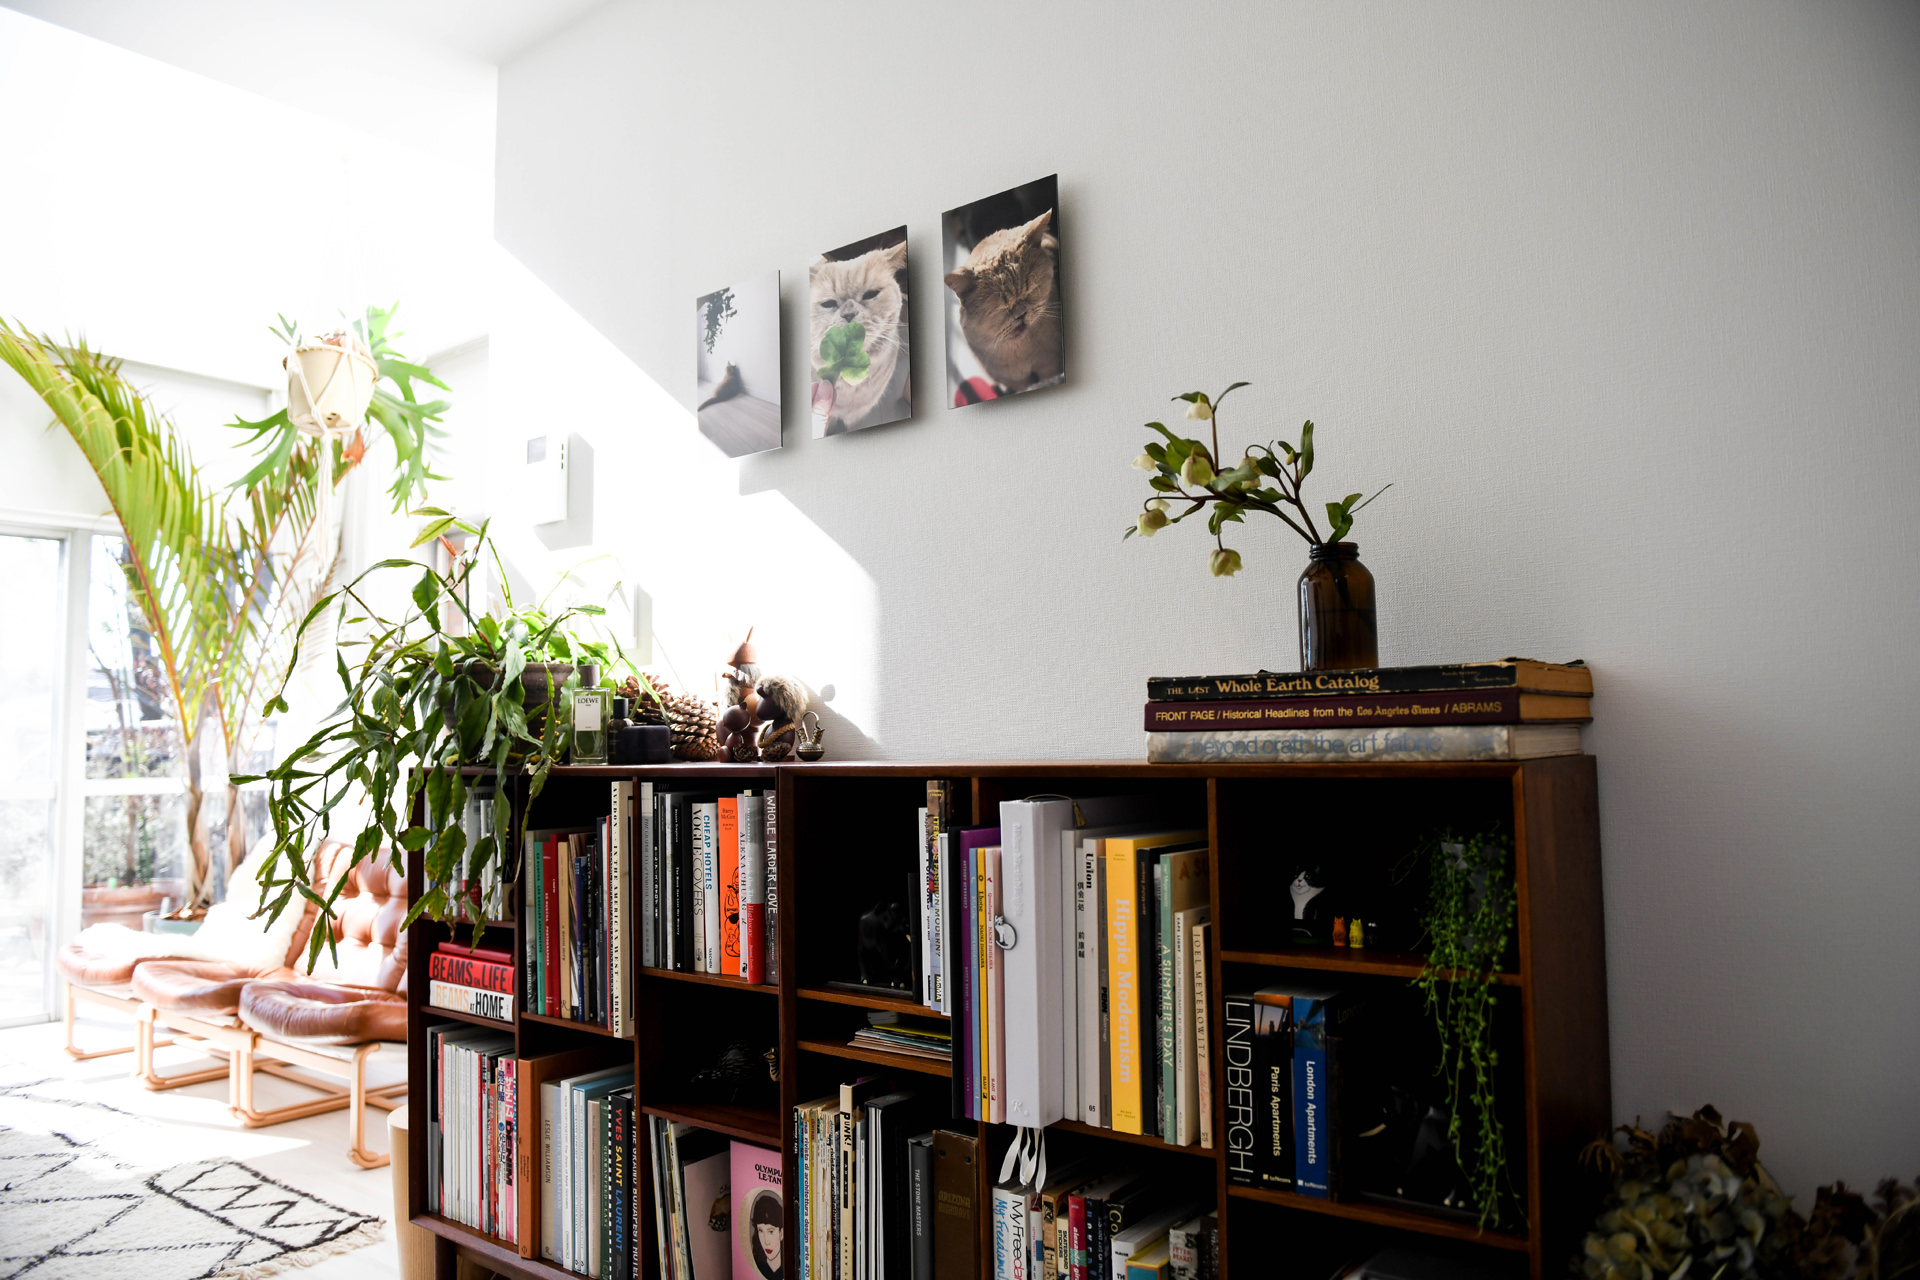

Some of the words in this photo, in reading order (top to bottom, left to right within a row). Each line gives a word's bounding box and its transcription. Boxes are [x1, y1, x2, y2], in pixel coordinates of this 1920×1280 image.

[1167, 687, 1184, 695] THE
[1188, 686, 1210, 695] LAST
[1215, 680, 1262, 693] Whole
[1267, 678, 1312, 692] Earth
[1316, 675, 1380, 690] Catalog
[1155, 711, 1187, 721] FRONT
[1190, 710, 1215, 720] PAGE
[1223, 709, 1262, 720] Historical
[1265, 708, 1310, 718] Headlines
[1313, 707, 1335, 717] from
[1338, 706, 1353, 716] the
[1357, 706, 1372, 716] Los
[1375, 705, 1409, 718] Angeles
[1411, 705, 1440, 715] Times
[1451, 702, 1502, 714] ABRAMS
[1192, 738, 1258, 759] beyond
[1314, 735, 1345, 753] the
[1350, 735, 1379, 753] art
[1384, 732, 1443, 753] fabric
[693, 809, 702, 856] VOGUE
[704, 815, 712, 847] CHEAP
[767, 796, 777, 834] WHOLE
[613, 845, 620, 856] IN
[767, 840, 777, 881] LARDER
[693, 857, 703, 916] COVERS
[704, 852, 712, 890] HOTELS
[1086, 853, 1094, 889] Union
[768, 887, 778, 914] LOVE
[1113, 899, 1130, 965] Hippie
[1194, 934, 1202, 965] JOEL
[1162, 945, 1172, 956] A
[433, 956, 473, 987] BEAMS
[482, 964, 508, 992] LIFE
[436, 984, 469, 1013] BEAMS
[475, 992, 505, 1019] HOME
[1162, 960, 1172, 1033] SUMMER'S
[1117, 970, 1131, 1083] Modernism
[1195, 971, 1206, 1059] MEYEROWITZ
[1163, 1037, 1173, 1067] DAY
[1225, 1001, 1254, 1174] LINDBERGH
[1270, 1066, 1280, 1094] Paris
[1305, 1060, 1316, 1100] London
[615, 1108, 623, 1142] YVES
[1089, 1104, 1096, 1112] 05
[840, 1111, 852, 1146] PUNK!
[1271, 1095, 1282, 1157] Apartments
[1306, 1102, 1317, 1165] Apartments
[505, 1120, 513, 1187] DENIM
[615, 1145, 623, 1188] SAINT
[804, 1163, 810, 1171] di
[938, 1190, 971, 1208] ARIZONA
[993, 1197, 1008, 1220] My
[1010, 1200, 1024, 1225] My
[615, 1189, 623, 1253] LAURENT
[1173, 1247, 1192, 1255] PETER
[1173, 1253, 1193, 1263] BEARD
